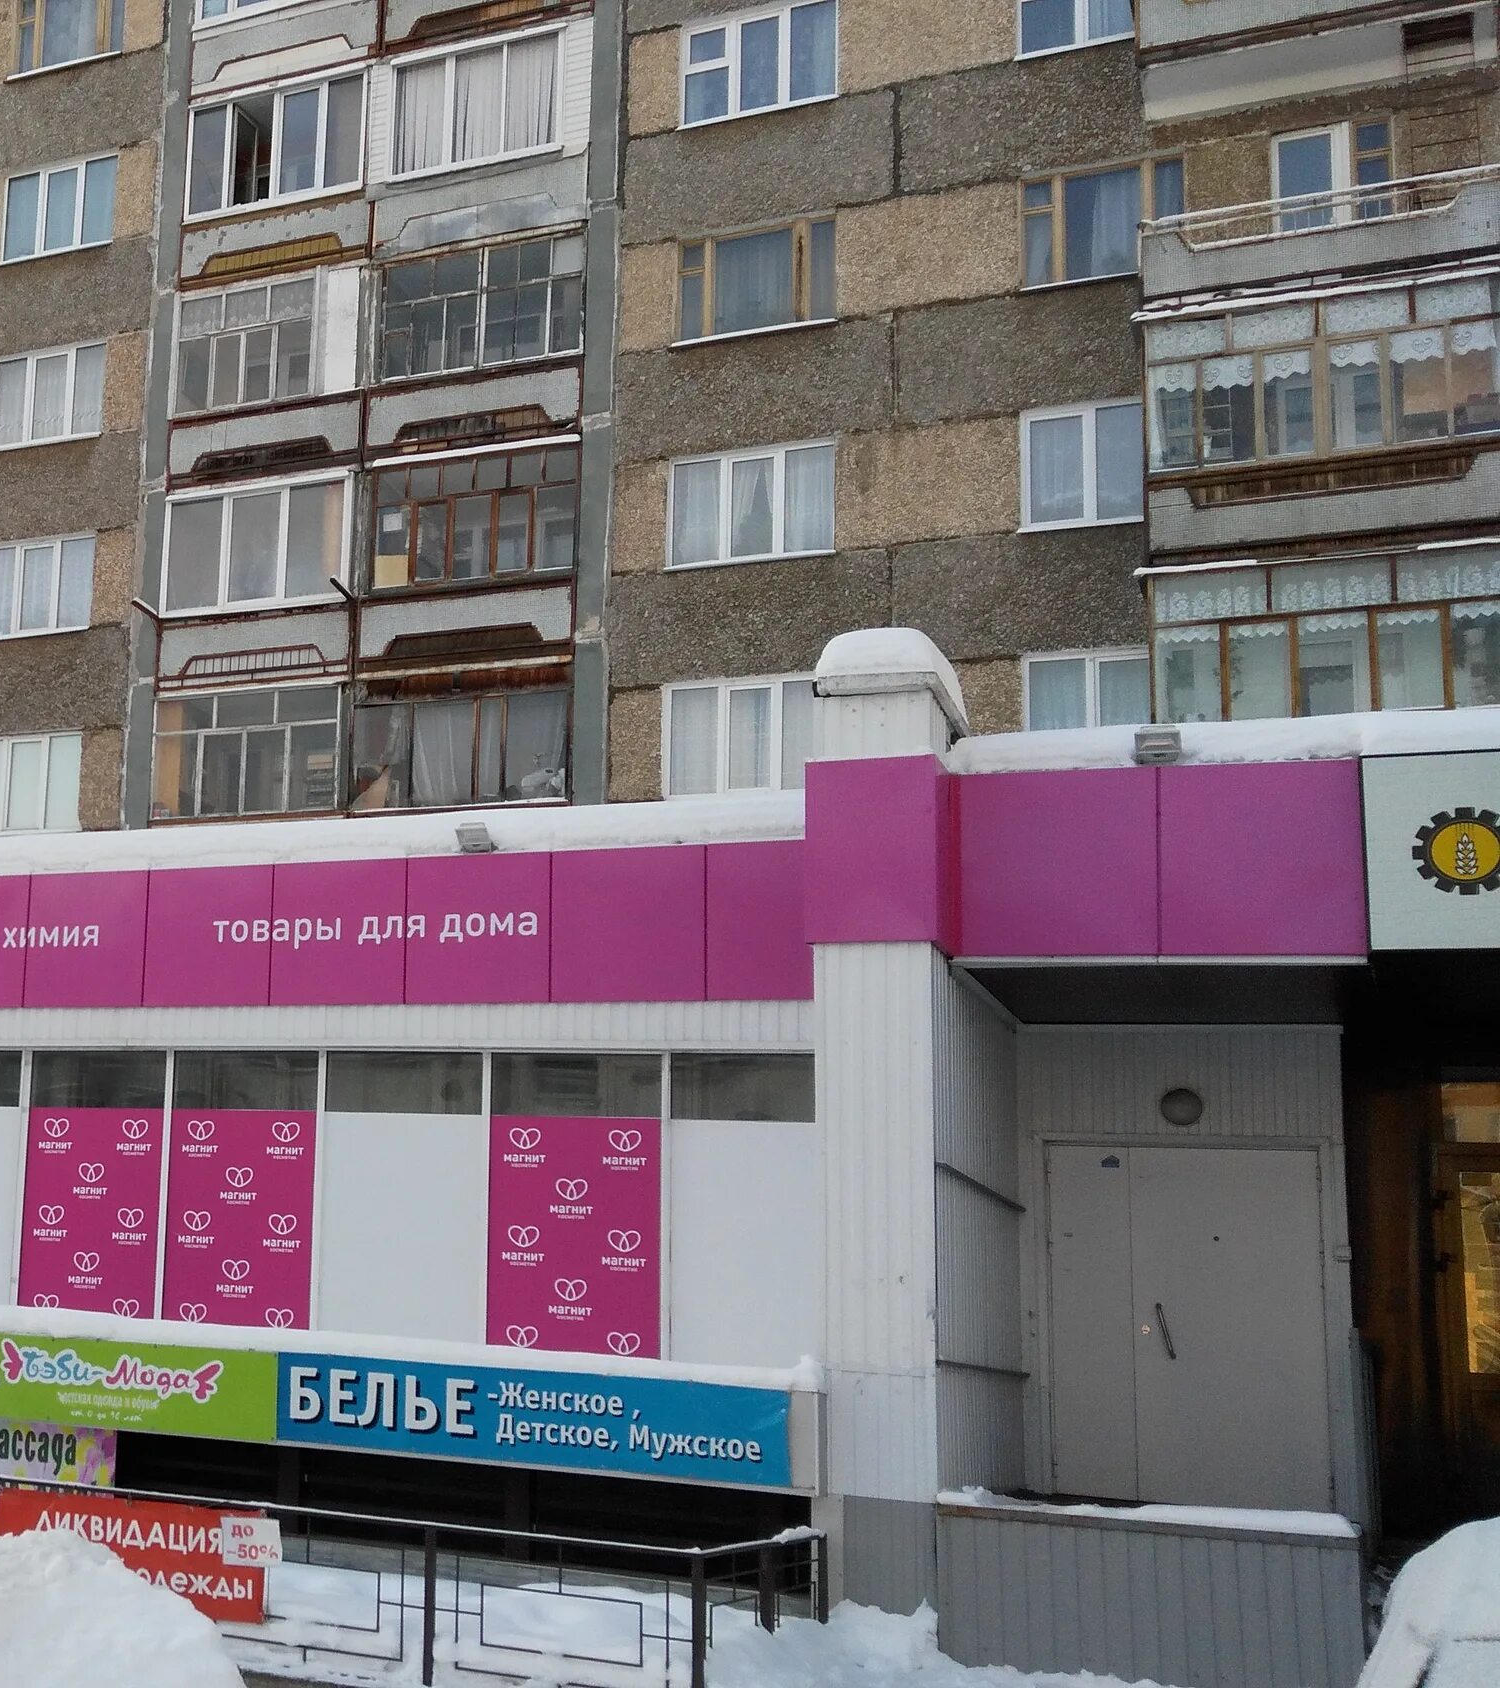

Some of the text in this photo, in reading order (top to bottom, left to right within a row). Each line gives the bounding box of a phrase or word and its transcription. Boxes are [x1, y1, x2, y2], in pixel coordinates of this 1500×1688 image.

[2, 925, 100, 949] химия
[213, 911, 539, 950] товары для дома
[288, 1366, 477, 1436] БЕЛЬЕ
[496, 1414, 762, 1462] Детское, Мужское
[35, 1510, 223, 1554] ЛИКВИДАЦИЯ
